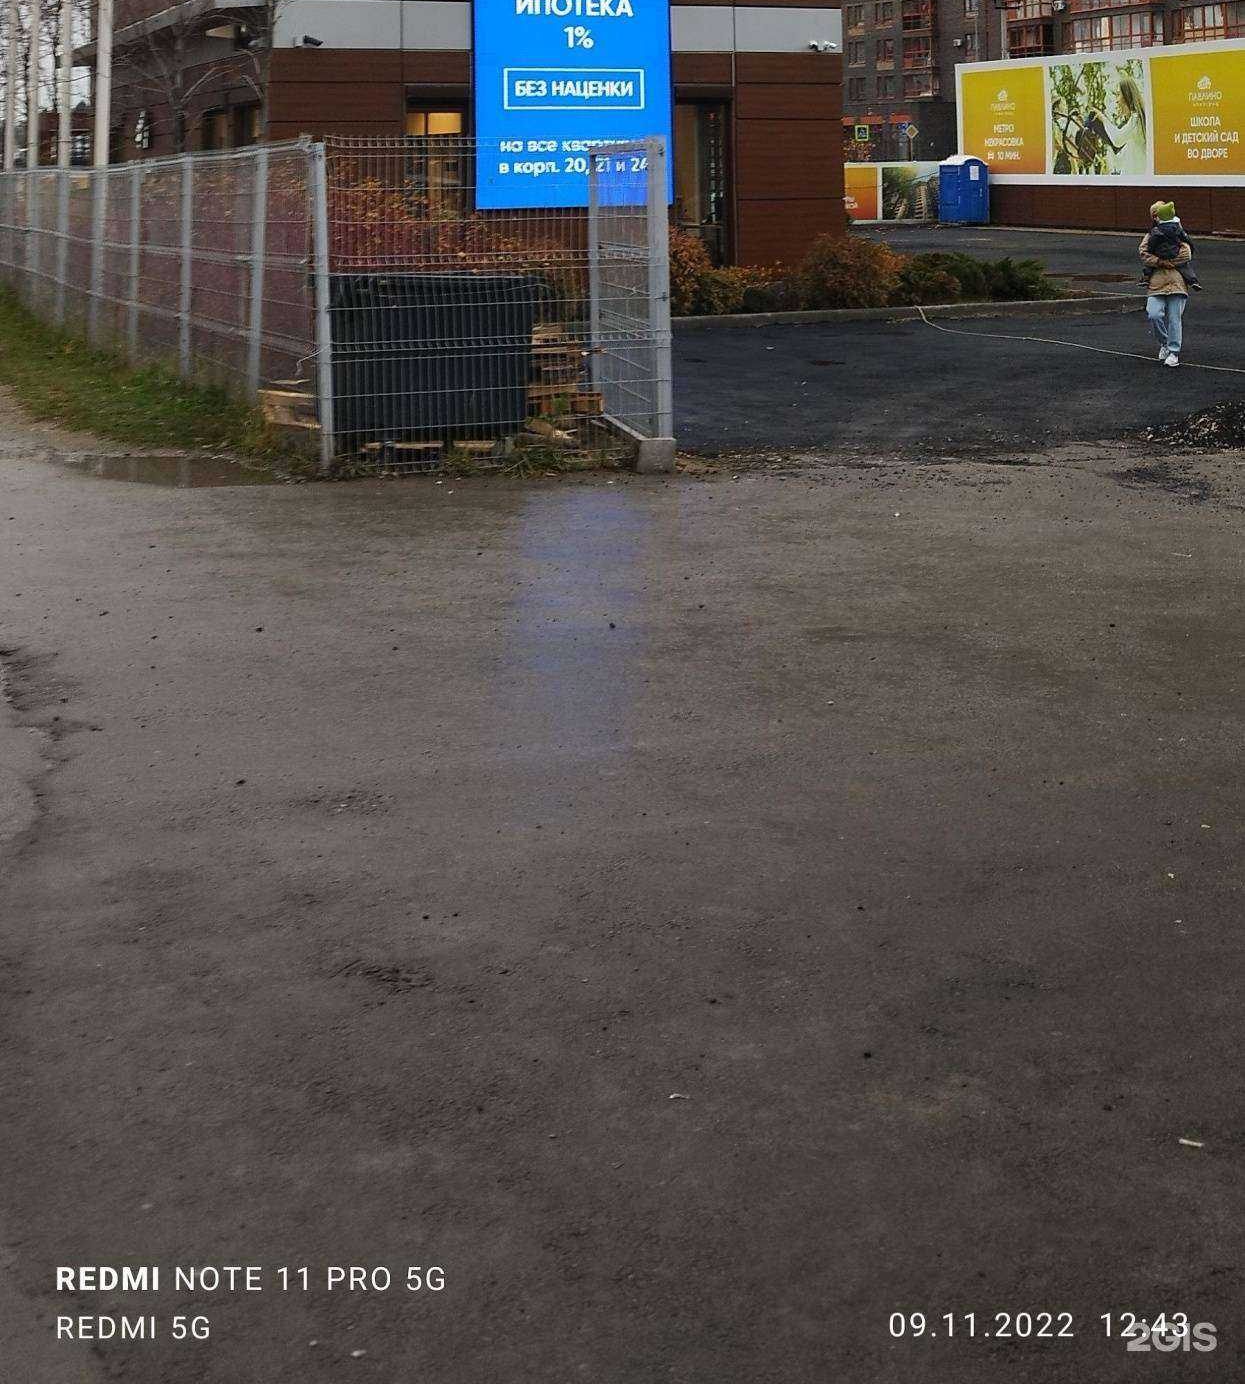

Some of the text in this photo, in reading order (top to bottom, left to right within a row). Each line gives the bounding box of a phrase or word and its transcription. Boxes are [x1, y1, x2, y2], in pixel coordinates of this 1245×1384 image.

[563, 25, 594, 49] 1%
[515, 80, 633, 99] БЕЗ НАЦЕНКИ
[1191, 116, 1221, 127] ШКОЛА
[1174, 129, 1240, 144] И ДЕТСКИЙ САД
[500, 140, 523, 152] на
[527, 140, 557, 152] все
[1187, 148, 1229, 160] ВО ДВОРЕ
[499, 162, 509, 174] в
[513, 161, 560, 177] корп.
[564, 157, 590, 175] 20,
[616, 161, 625, 172] и
